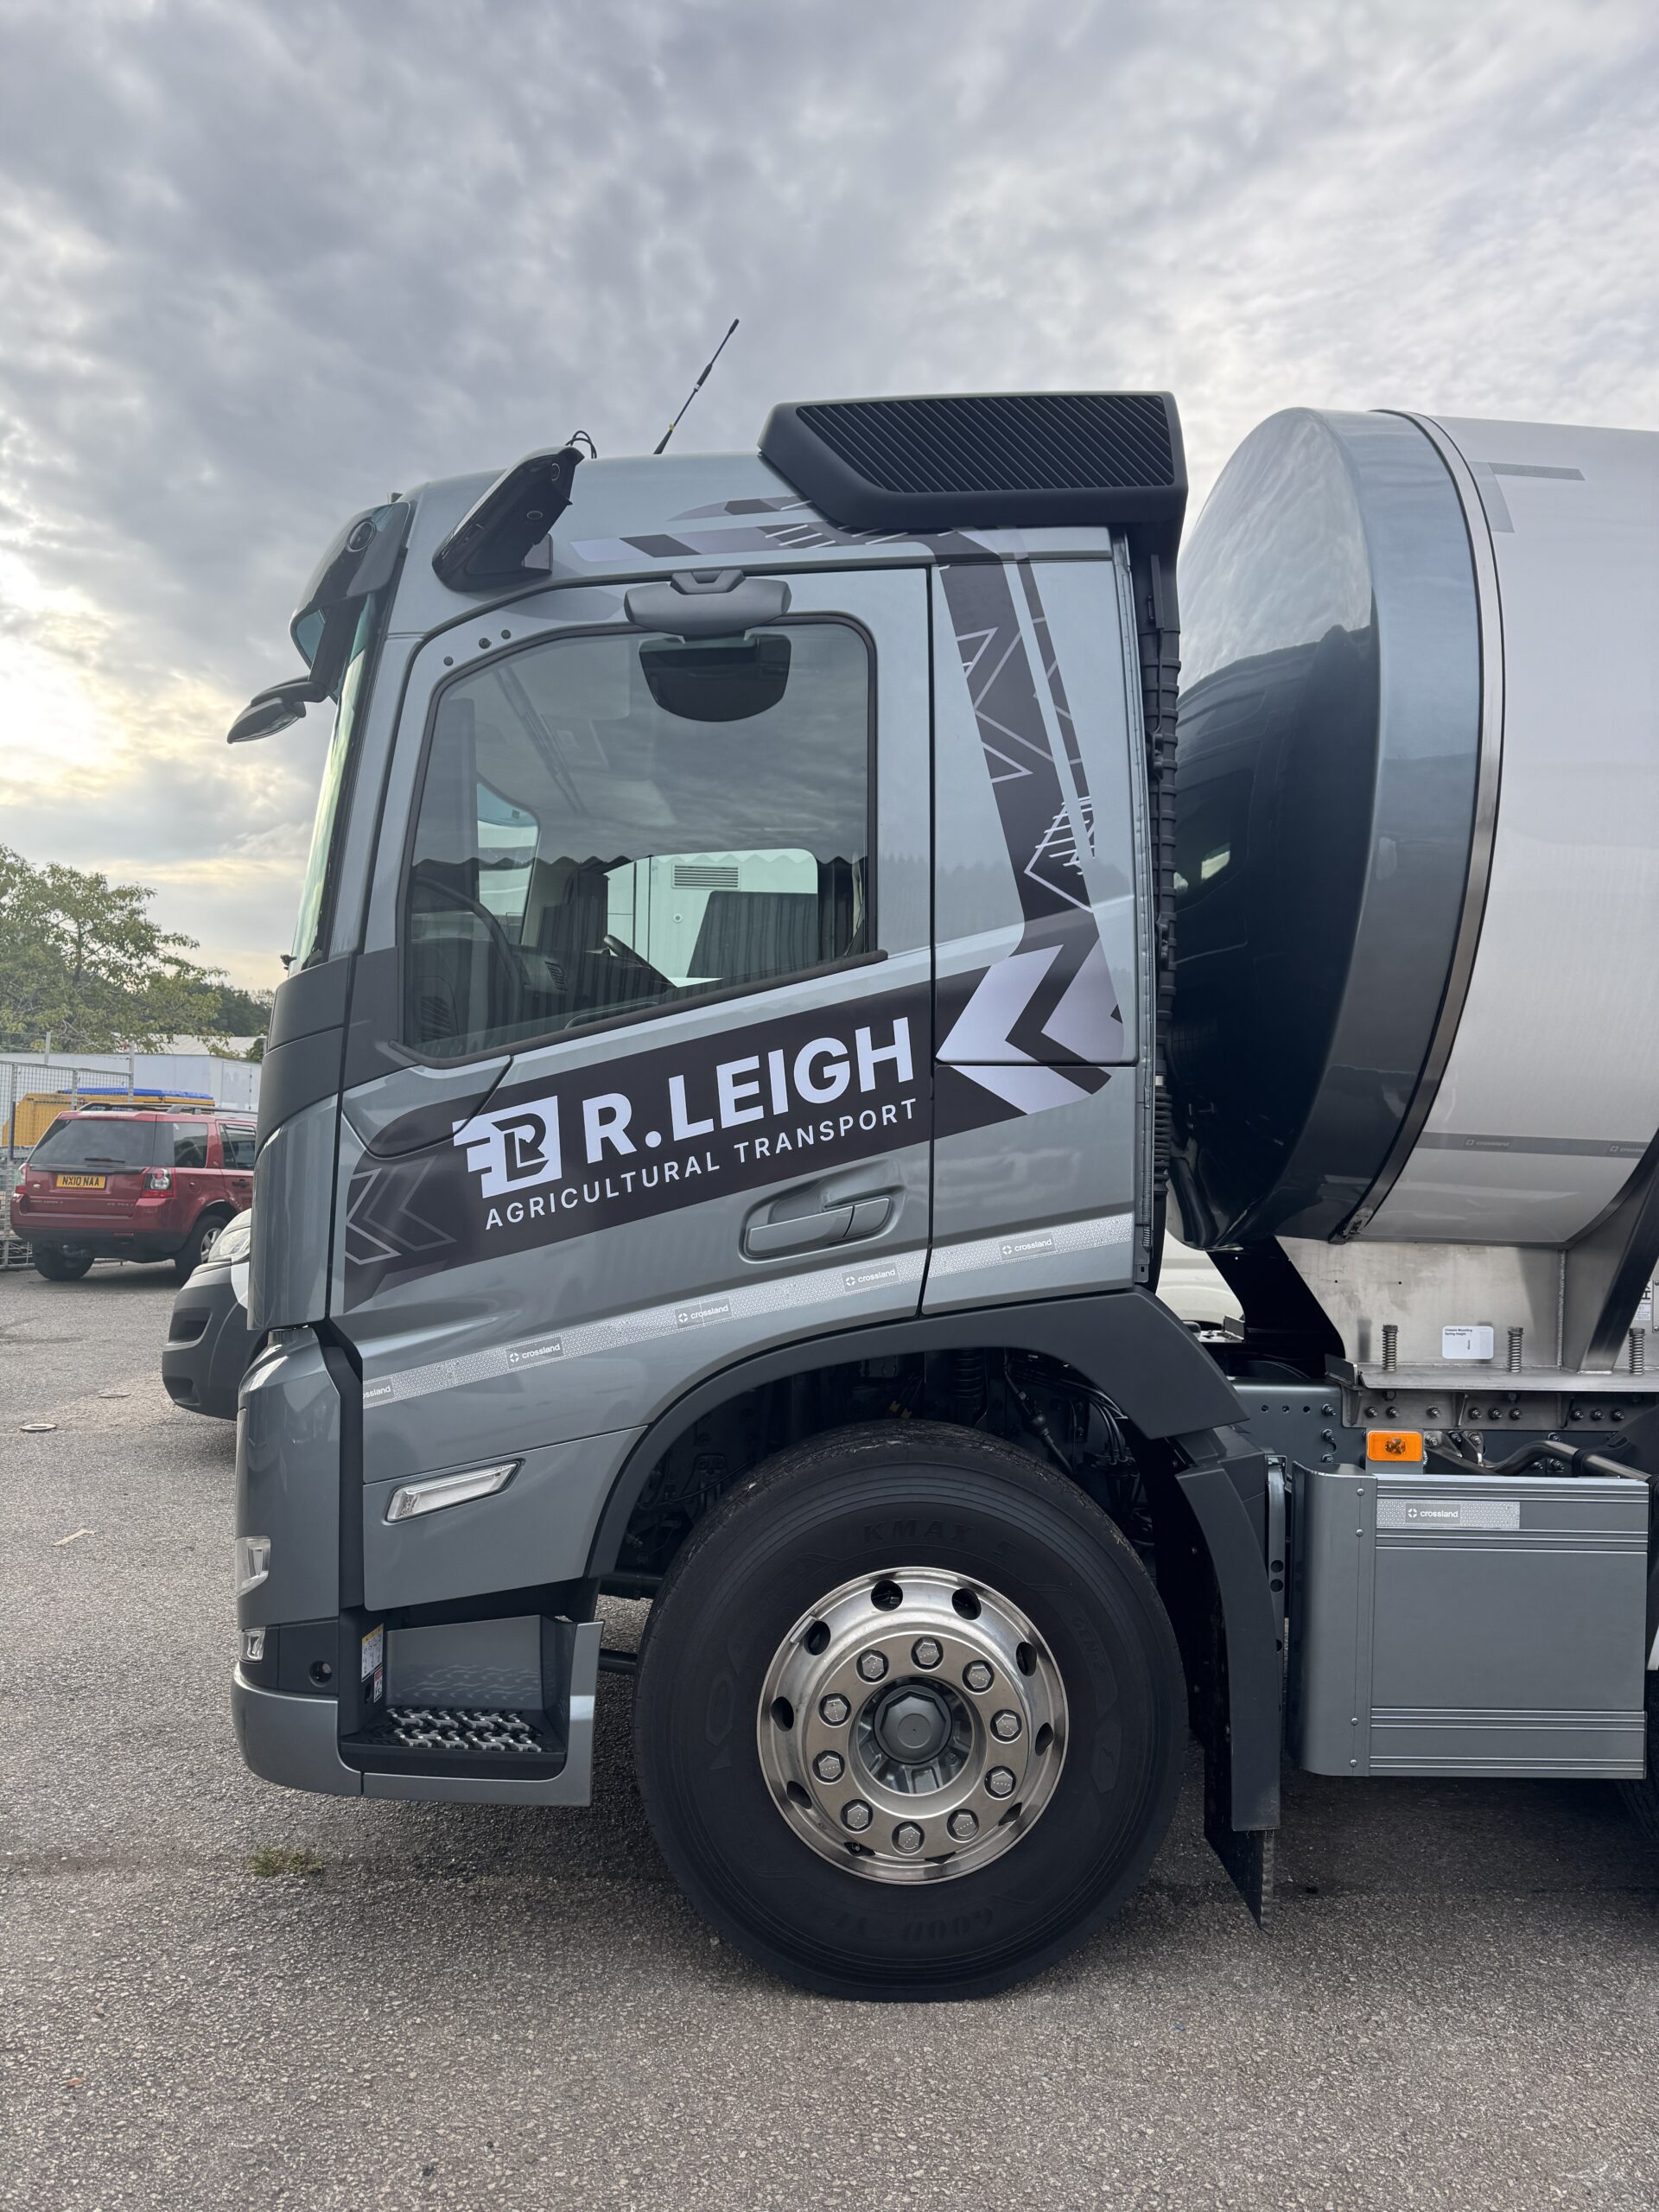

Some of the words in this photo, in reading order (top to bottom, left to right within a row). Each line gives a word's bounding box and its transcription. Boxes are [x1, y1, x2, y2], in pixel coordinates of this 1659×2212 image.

[582, 1016, 914, 1164] R.LEIGH
[485, 1151, 721, 1230] AGRICULTURAL
[734, 1097, 917, 1164] TRANSPORT
[62, 1176, 81, 1186] NX10
[83, 1177, 99, 1187] NAA
[1014, 1238, 1052, 1252] crossland
[857, 1268, 896, 1282] crossland
[690, 1304, 729, 1319] crossland
[521, 1343, 561, 1358] crossland
[1420, 1510, 1459, 1518] crossland
[862, 1518, 976, 1546] KMAX
